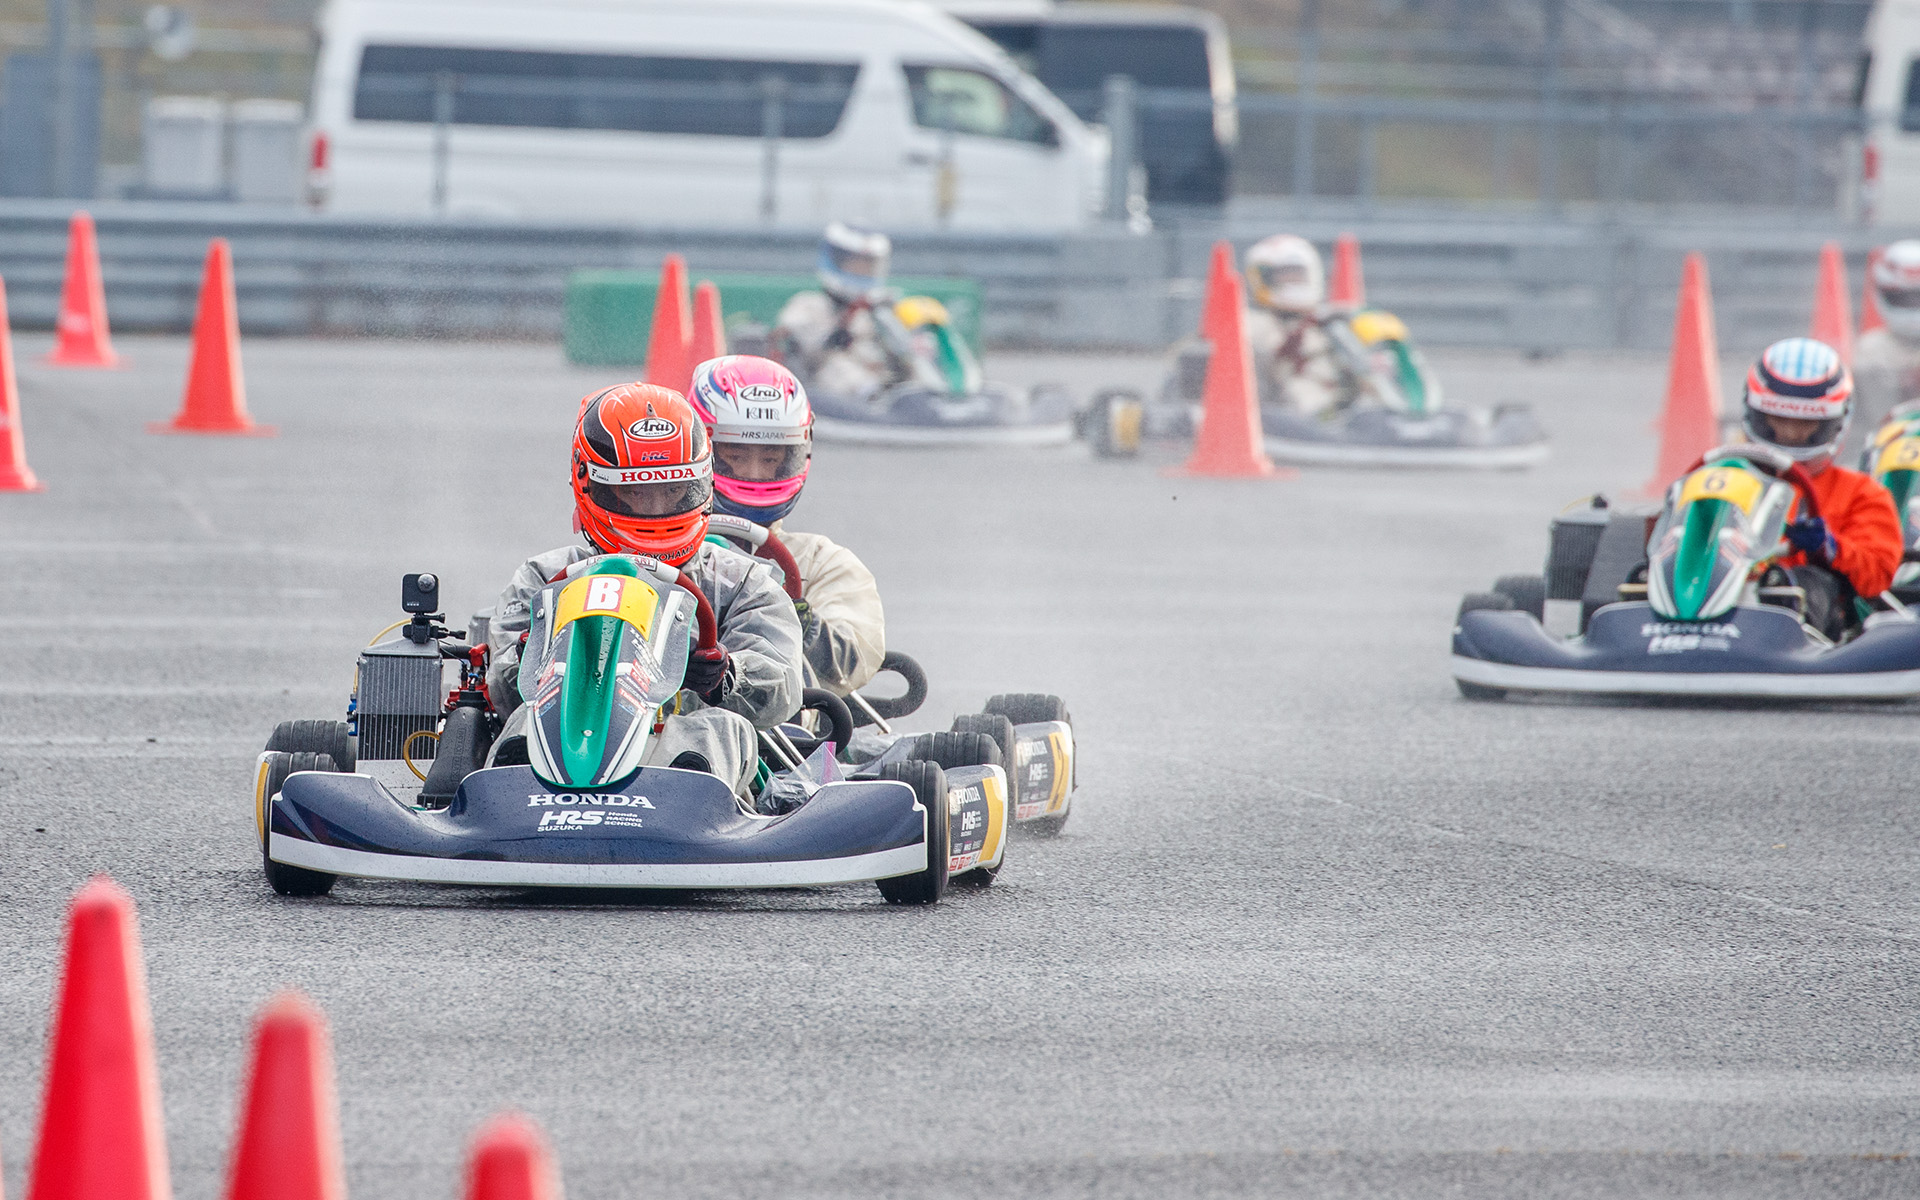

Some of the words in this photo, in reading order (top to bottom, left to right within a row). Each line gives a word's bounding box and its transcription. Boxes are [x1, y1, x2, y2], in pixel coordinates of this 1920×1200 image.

[743, 386, 777, 398] Arai
[633, 419, 670, 434] Arai
[641, 450, 671, 462] HRC
[620, 468, 696, 482] HONDA
[1703, 471, 1726, 493] 6
[637, 544, 695, 562] YOKOHAMA
[586, 576, 621, 611] B
[527, 793, 657, 810] HONDA
[539, 810, 606, 826] HRS
